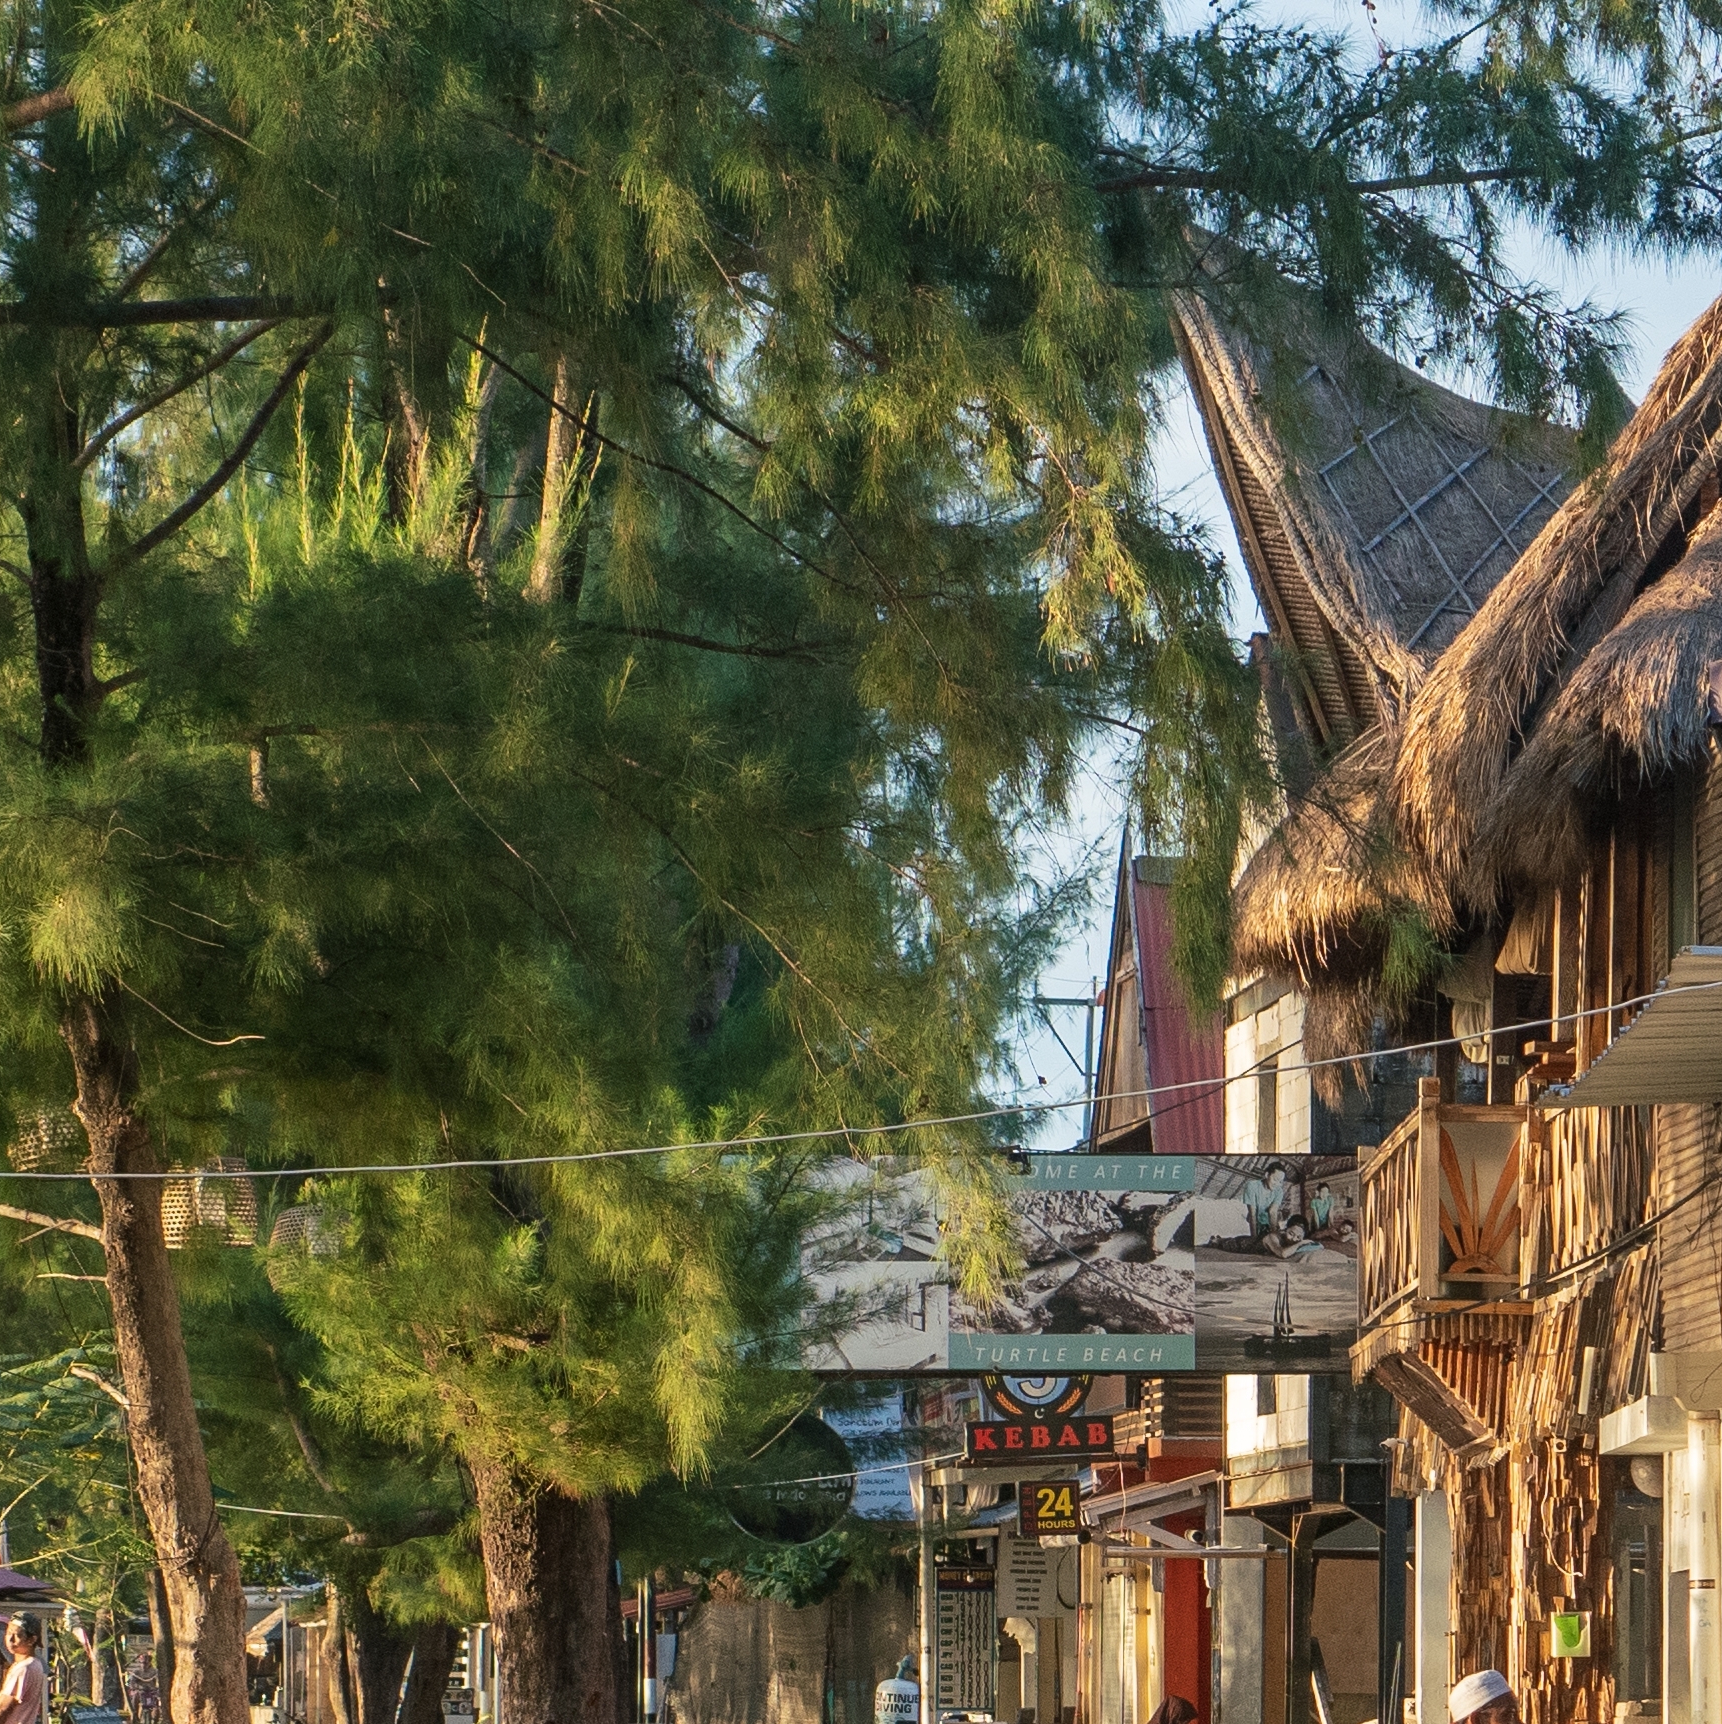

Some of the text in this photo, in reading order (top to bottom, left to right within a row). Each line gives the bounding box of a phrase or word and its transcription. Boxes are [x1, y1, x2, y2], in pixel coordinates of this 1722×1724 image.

[1093, 1164, 1123, 1181] AT
[1138, 1164, 1184, 1181] THE
[976, 1347, 1164, 1363] TURTLE BEACH
[974, 1423, 1108, 1450] KEBAB
[1037, 1487, 1074, 1518] 24
[1037, 1519, 1076, 1530] HOURS
